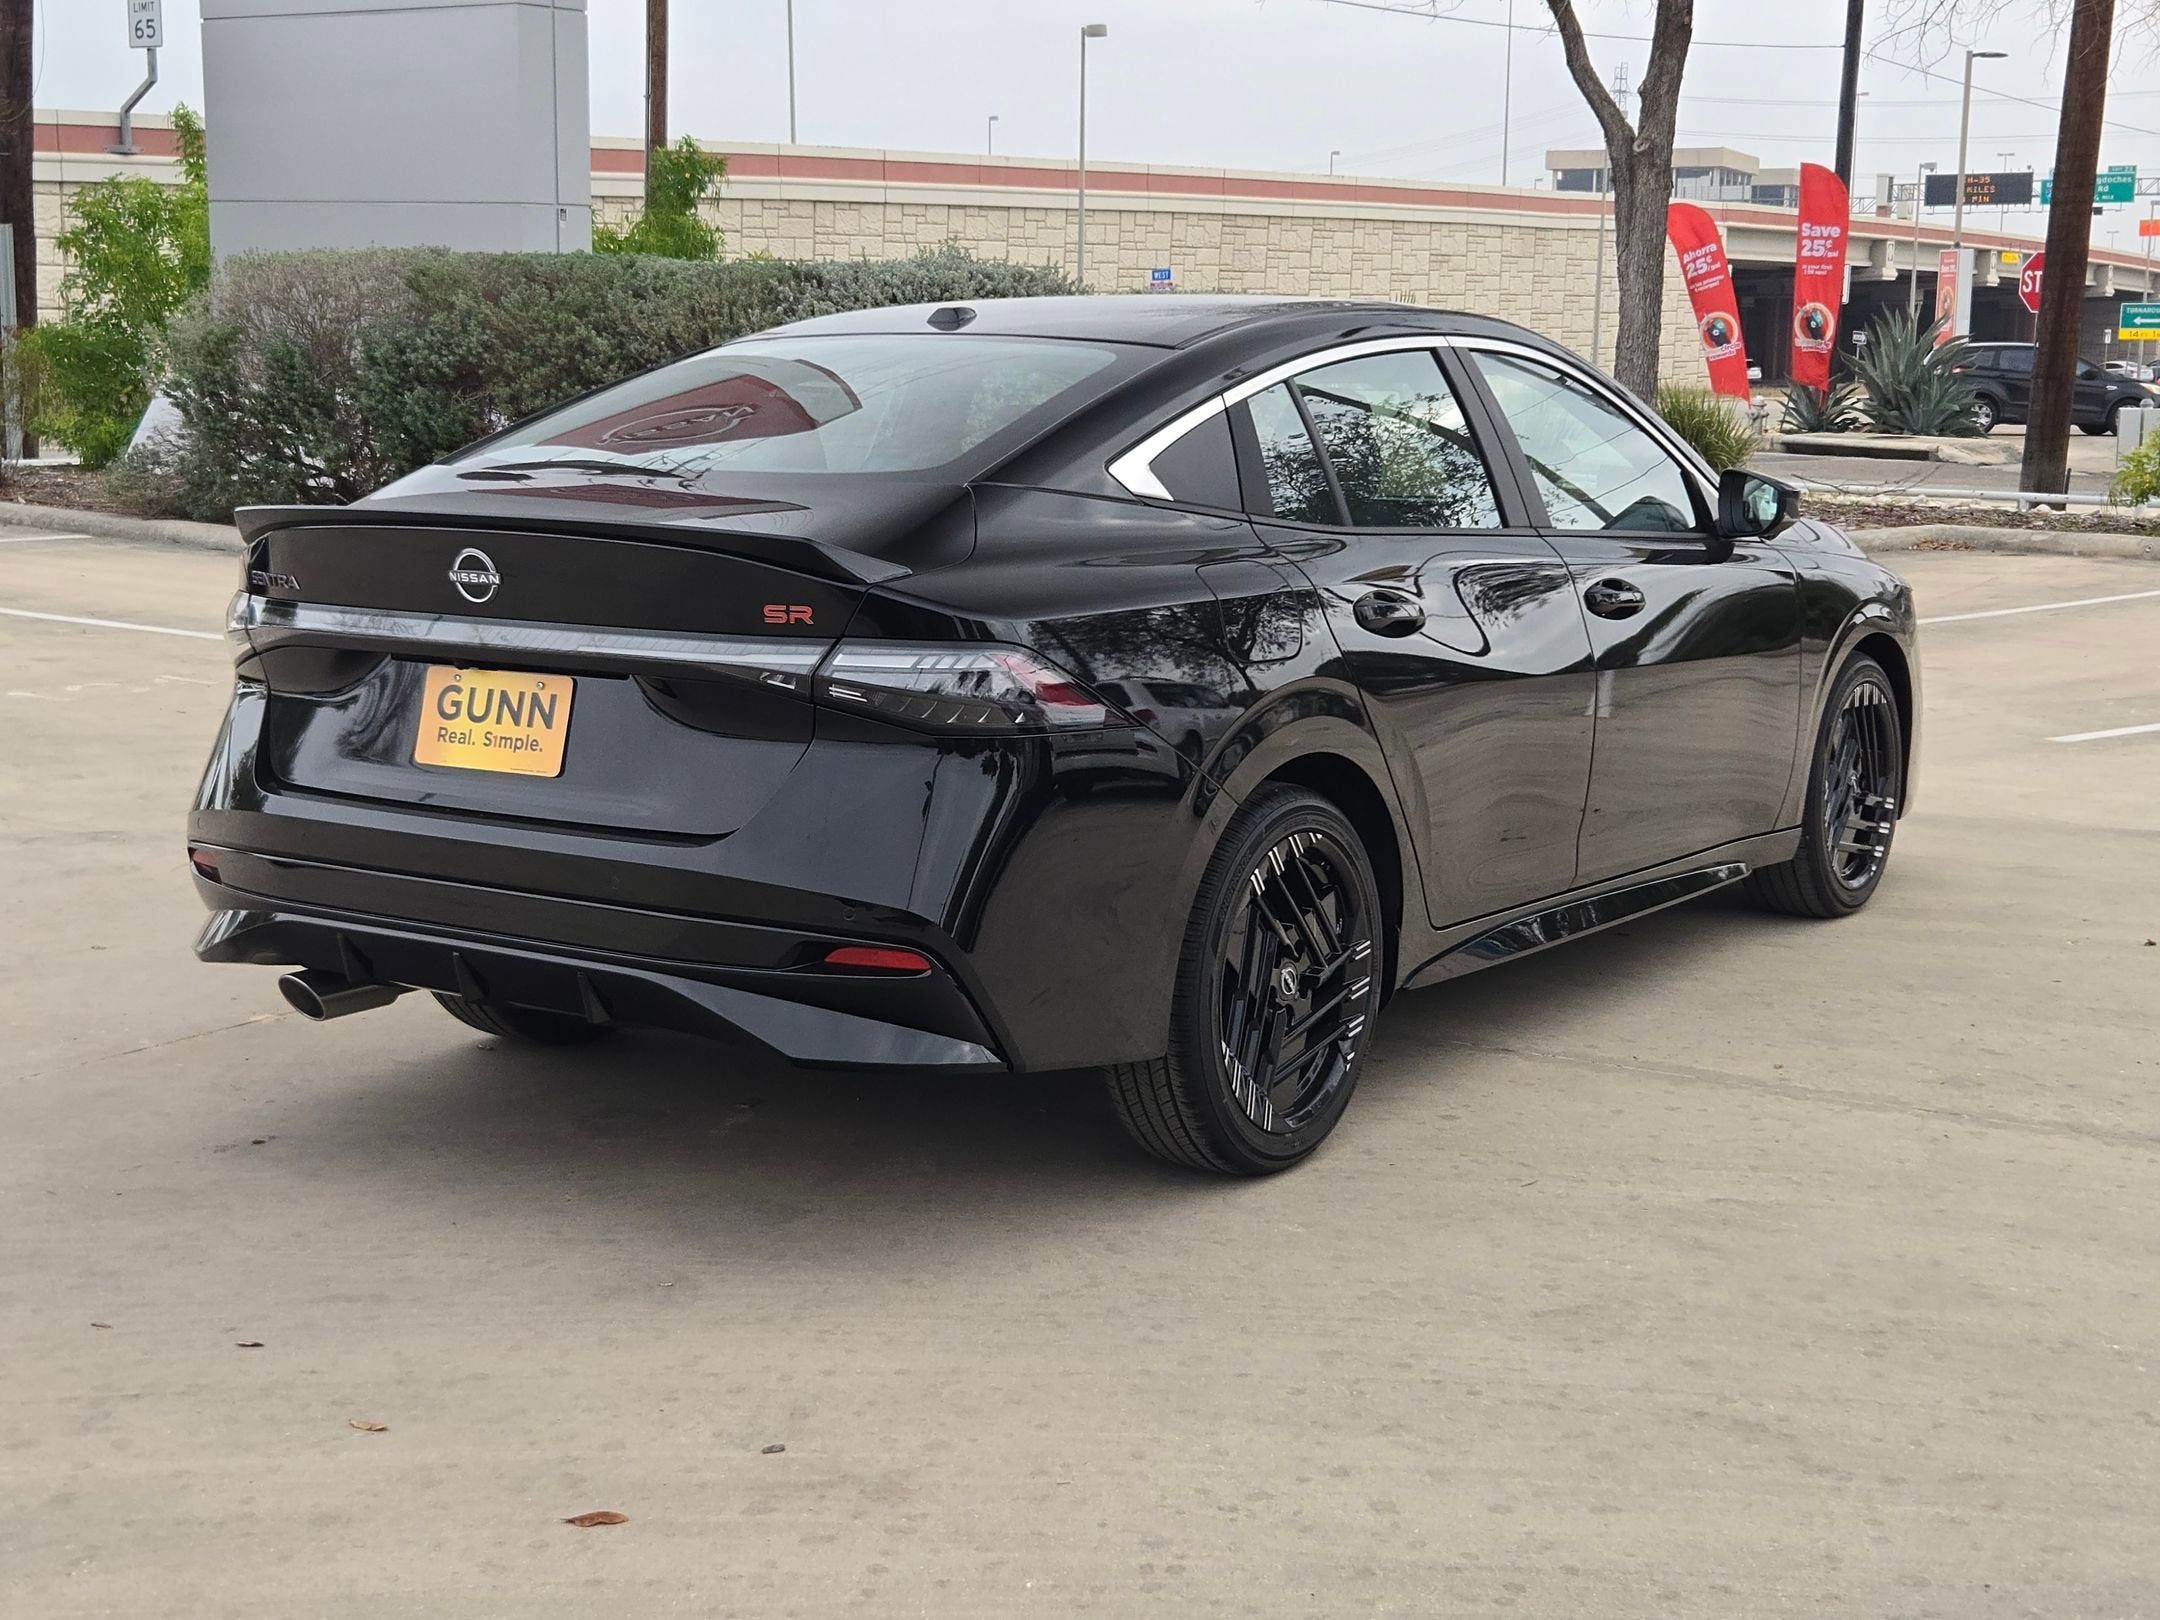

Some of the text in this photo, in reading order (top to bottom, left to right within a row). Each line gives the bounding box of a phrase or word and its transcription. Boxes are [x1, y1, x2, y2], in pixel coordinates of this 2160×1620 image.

[132, 1, 155, 13] LIMIT
[134, 18, 156, 39] 65
[1967, 175, 1991, 184] H-35
[2096, 175, 2133, 184] gdoches
[2097, 184, 2109, 192] Rd
[1971, 195, 1990, 203] MIN
[1801, 222, 1841, 238] Save
[1683, 243, 1717, 264] Ahorra
[1153, 270, 1169, 280] WEST
[2022, 270, 2043, 293] ST
[251, 570, 301, 590] SENTRA
[449, 570, 500, 585] NISSAN
[763, 604, 815, 625] SR
[436, 684, 558, 730] GUNN
[437, 726, 476, 747] Real.
